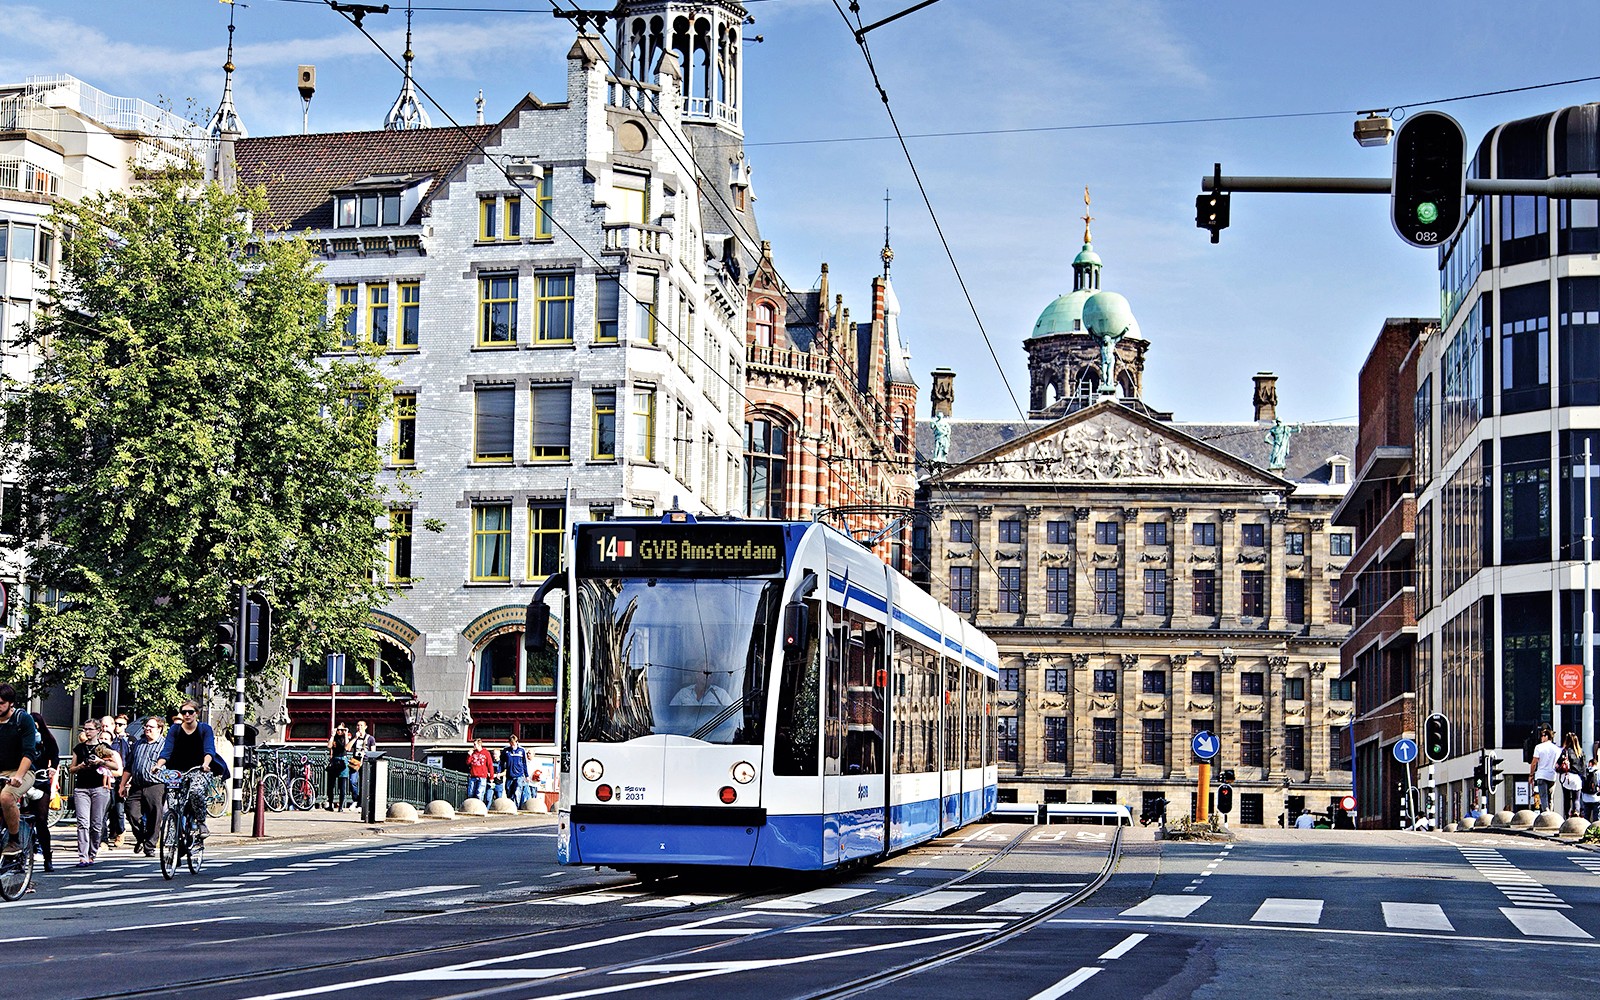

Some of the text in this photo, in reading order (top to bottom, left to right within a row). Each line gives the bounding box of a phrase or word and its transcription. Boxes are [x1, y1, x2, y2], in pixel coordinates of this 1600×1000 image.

[1415, 231, 1438, 242] 082
[596, 536, 777, 562] 14 GVB Amsterdam
[625, 793, 644, 801] 2031
